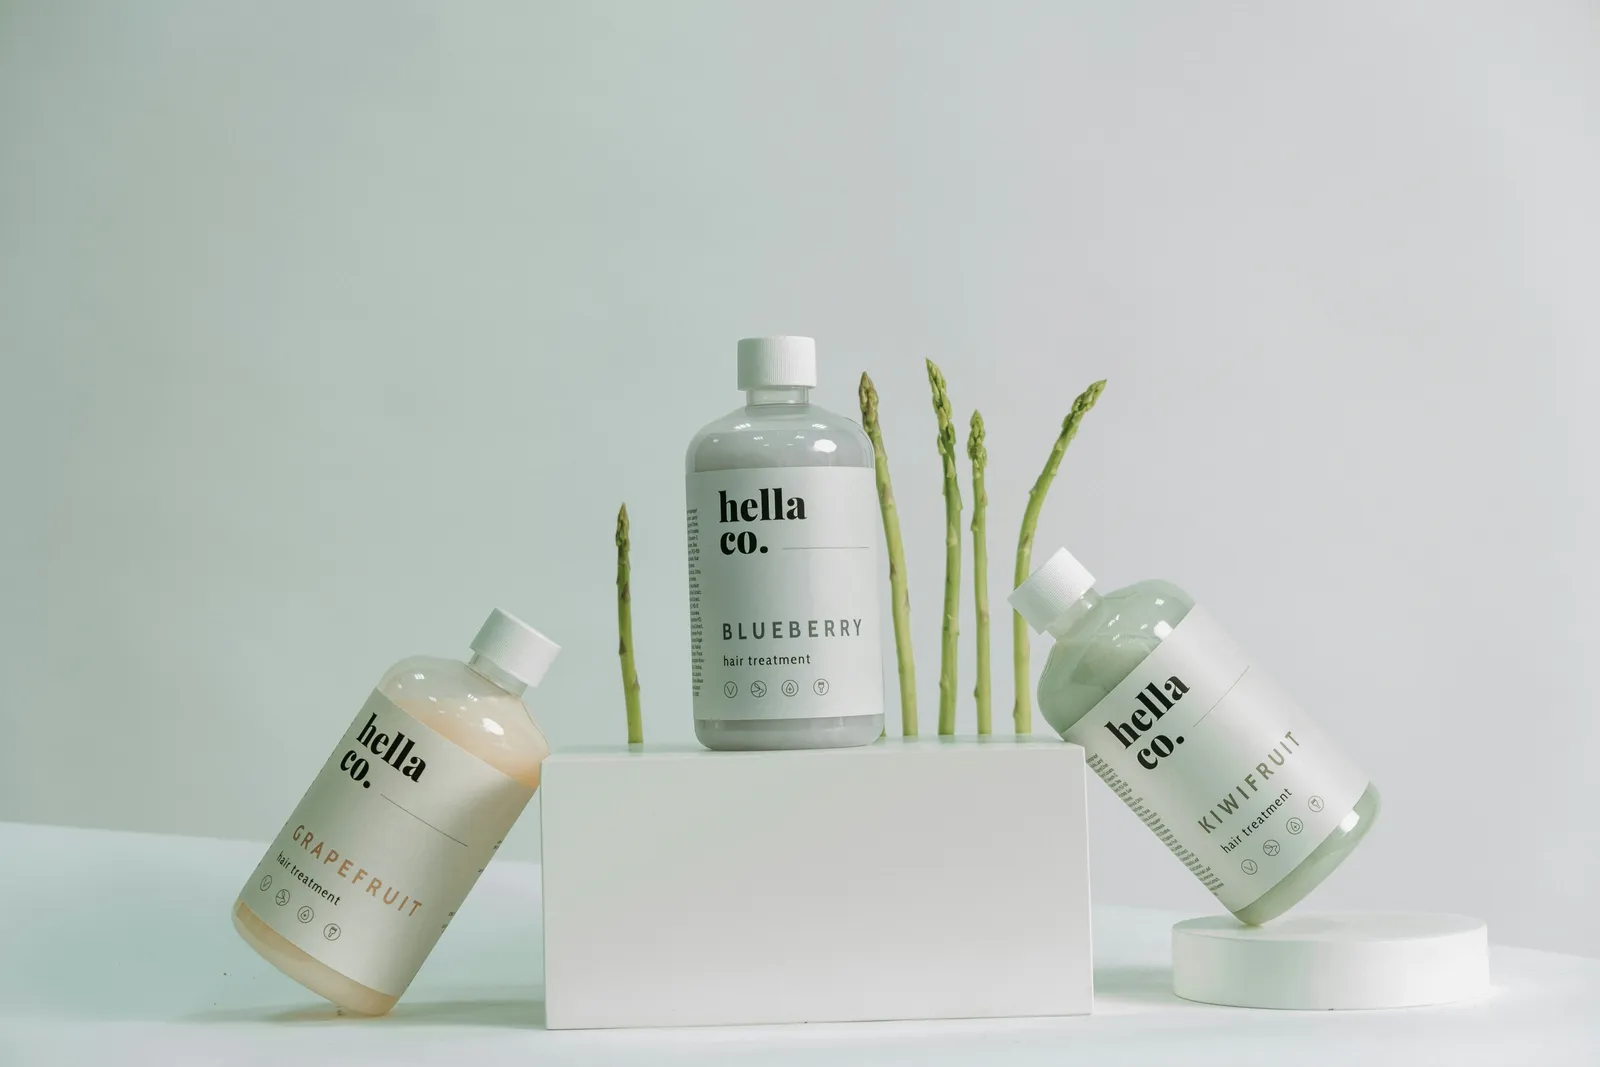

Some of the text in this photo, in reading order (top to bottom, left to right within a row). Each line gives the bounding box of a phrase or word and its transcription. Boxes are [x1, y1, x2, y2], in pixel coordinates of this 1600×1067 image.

[718, 488, 807, 523] hella
[720, 531, 769, 556] co.
[722, 618, 862, 641] BLUEBERRY
[723, 654, 811, 667] hair treatment
[1104, 675, 1191, 750] hella
[340, 750, 371, 789] co.
[355, 712, 427, 783] hella
[1136, 734, 1185, 770] co.
[1197, 730, 1300, 834] KIWIFRUIT
[1219, 787, 1293, 854] hair treatment
[275, 851, 341, 906] hair treatment
[292, 824, 423, 917] GRAPEFRUIT
